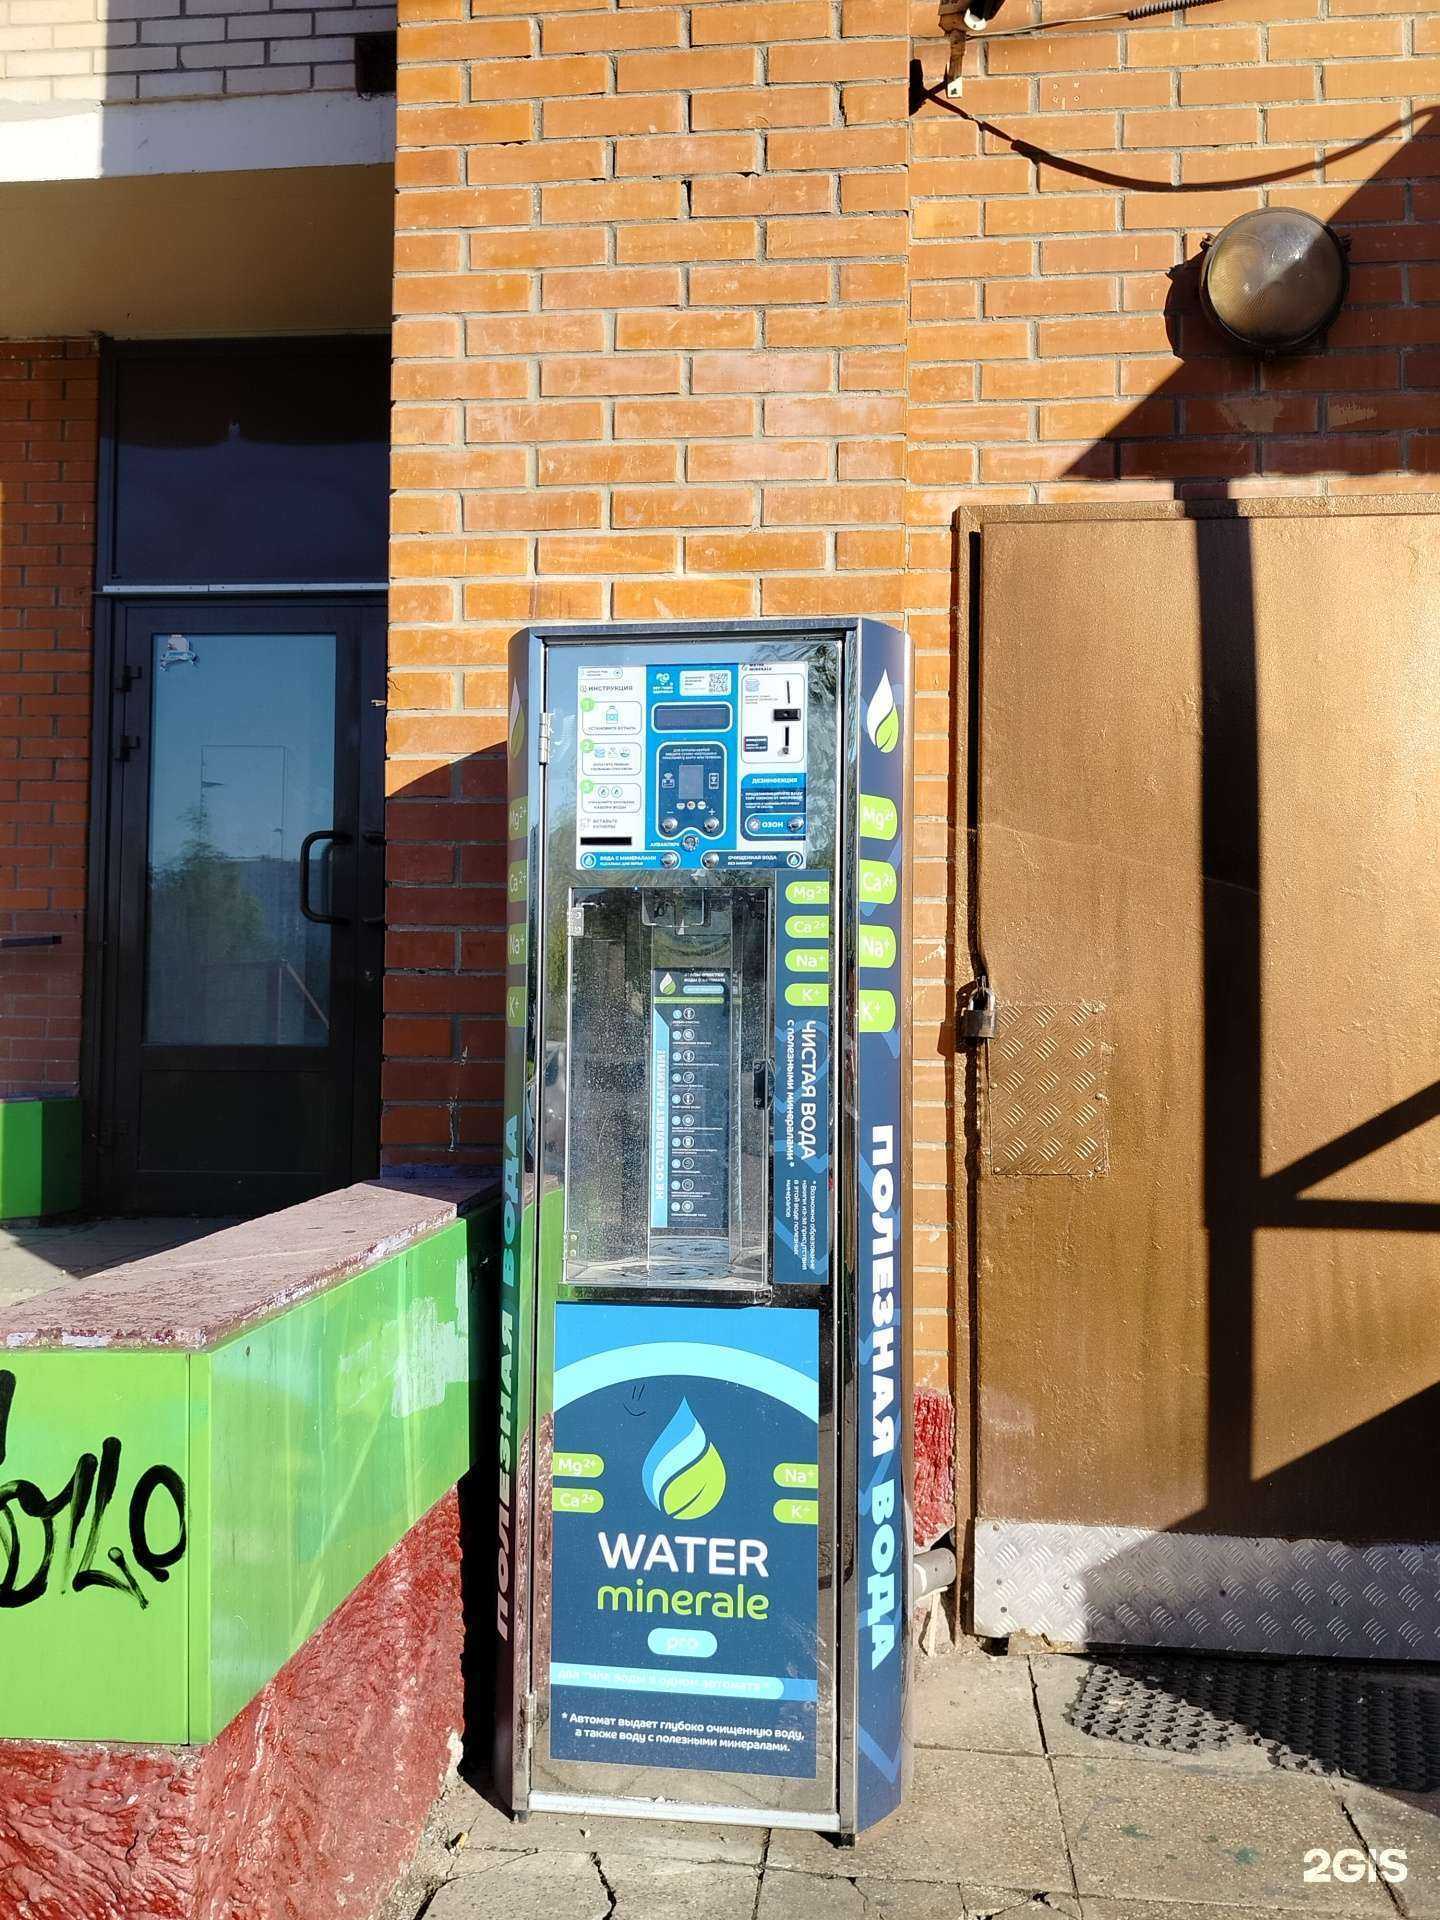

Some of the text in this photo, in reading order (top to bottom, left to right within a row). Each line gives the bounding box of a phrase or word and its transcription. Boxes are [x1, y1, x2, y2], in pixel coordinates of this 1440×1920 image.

[786, 1028, 794, 1090] полезными
[798, 1020, 816, 1160] ЧИСТАЯ ВОДА
[656, 1109, 665, 1182] ОСТАВЛЯЕТ
[785, 1092, 794, 1160] минералами
[656, 1184, 665, 1199] НЕ
[497, 1114, 518, 1641] ПОЛЕЗНАЯ ВОДА
[867, 1125, 895, 1671] ПОЛЕЗНАЯ ВОДА
[598, 1531, 769, 1578] WATER
[597, 1578, 769, 1620] minerale
[667, 1635, 699, 1652] pro
[569, 1713, 805, 1741] Автомат выдает глубоко очищенную воду,
[575, 1728, 791, 1752] а также воду с полезными минералами.
